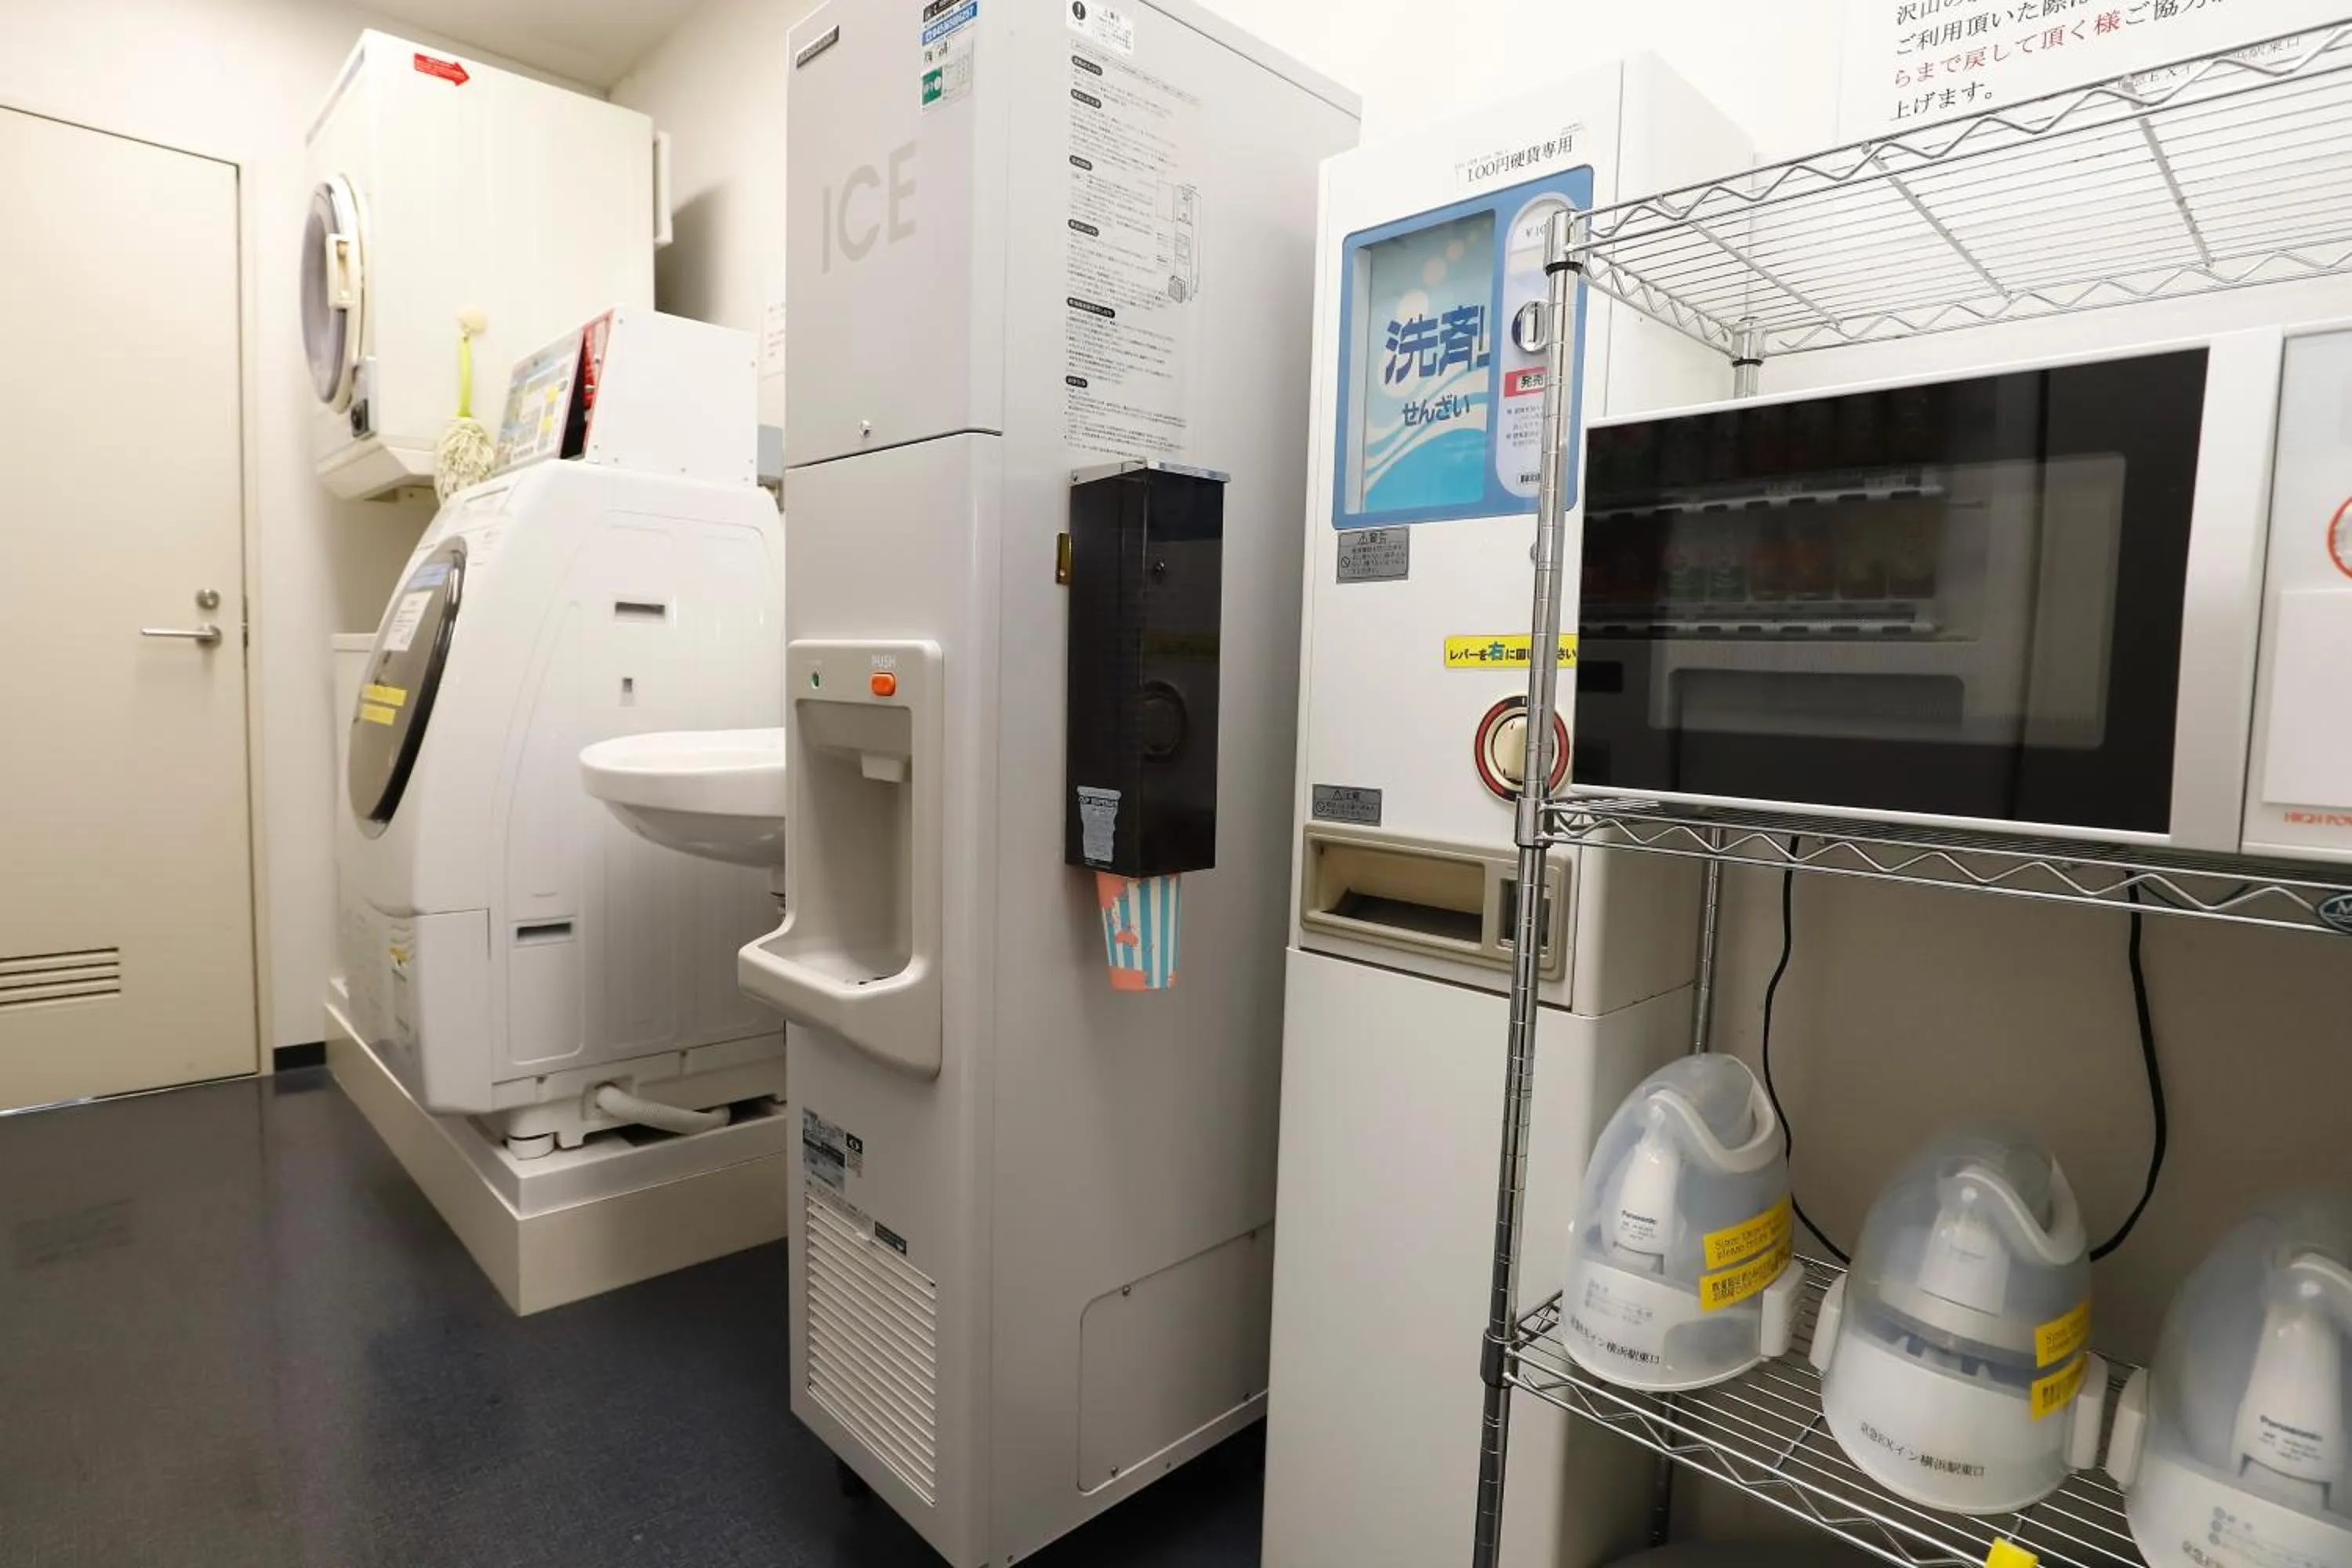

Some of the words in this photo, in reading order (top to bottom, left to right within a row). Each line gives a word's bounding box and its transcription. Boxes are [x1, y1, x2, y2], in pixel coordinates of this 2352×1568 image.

[1890, 82, 1992, 120] 上げます。
[822, 140, 916, 274] ICE
[1385, 305, 1490, 385] 洗剤
[1402, 394, 1471, 426] せんざい
